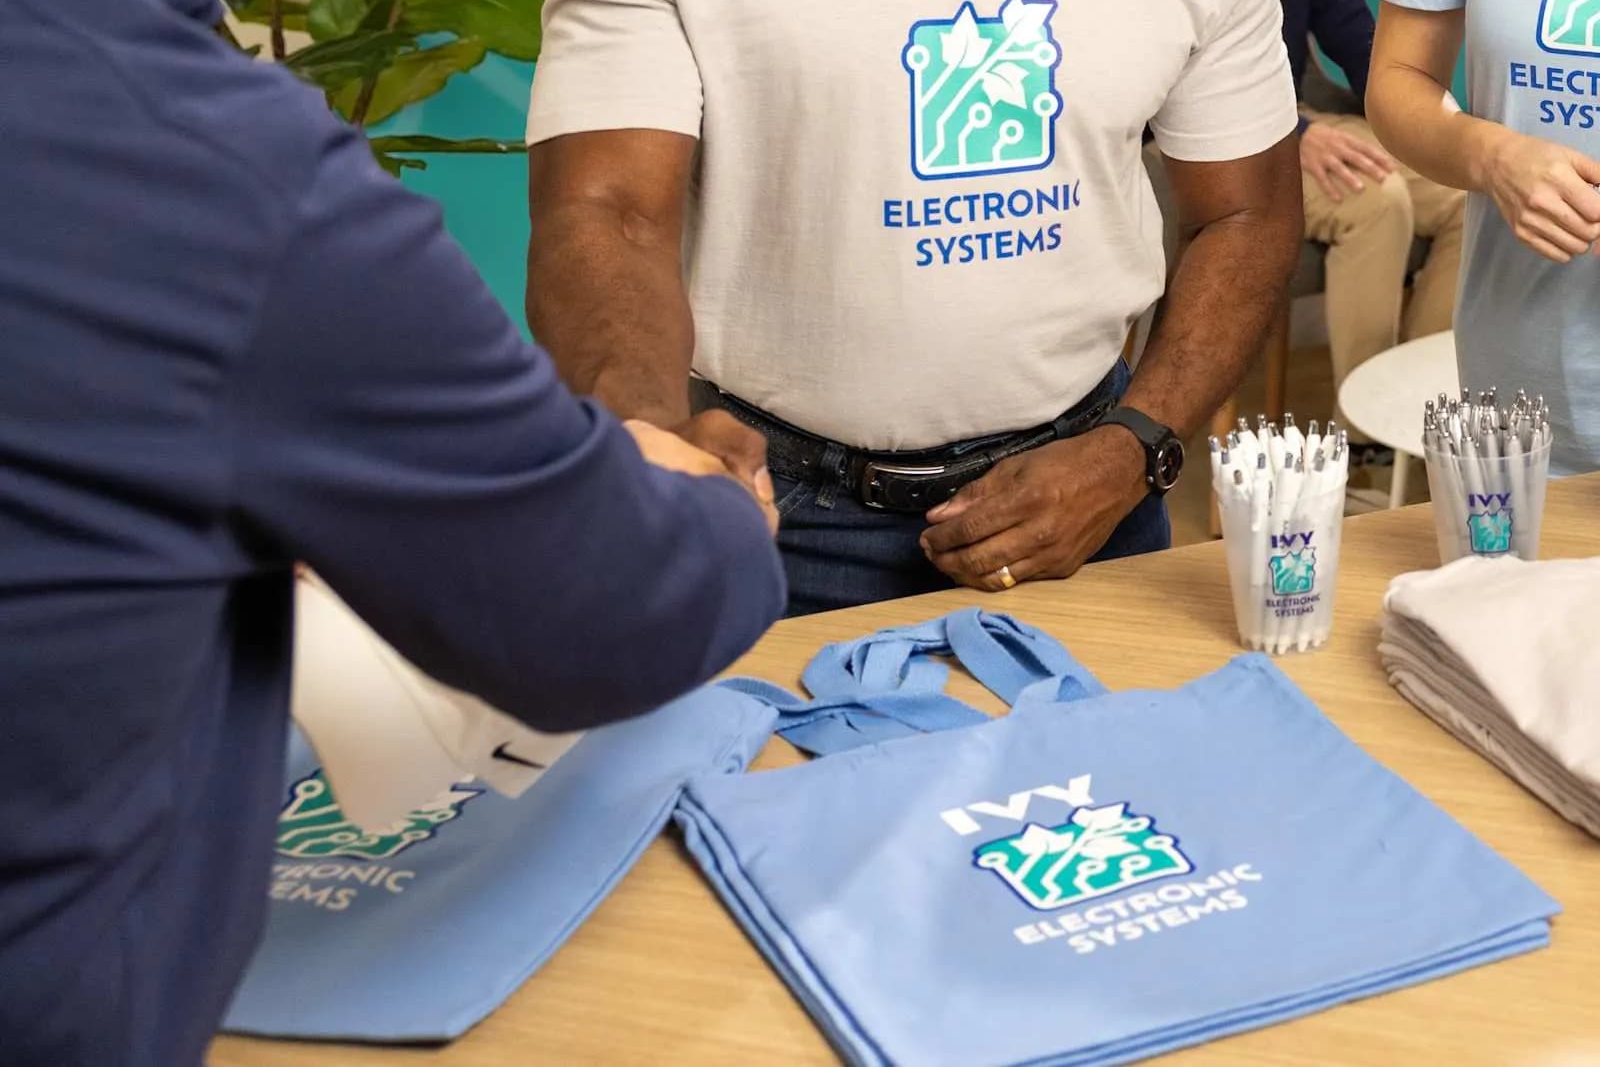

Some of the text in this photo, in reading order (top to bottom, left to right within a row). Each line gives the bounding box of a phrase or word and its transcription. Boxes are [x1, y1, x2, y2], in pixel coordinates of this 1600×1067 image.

[916, 223, 1062, 267] SYSTEMS
[1468, 493, 1511, 507] IVY
[1271, 531, 1314, 548] IVY
[939, 773, 1095, 836] IVY
[1013, 863, 1262, 945] ELECTRONIC
[1068, 889, 1248, 954] SYSTEMS
